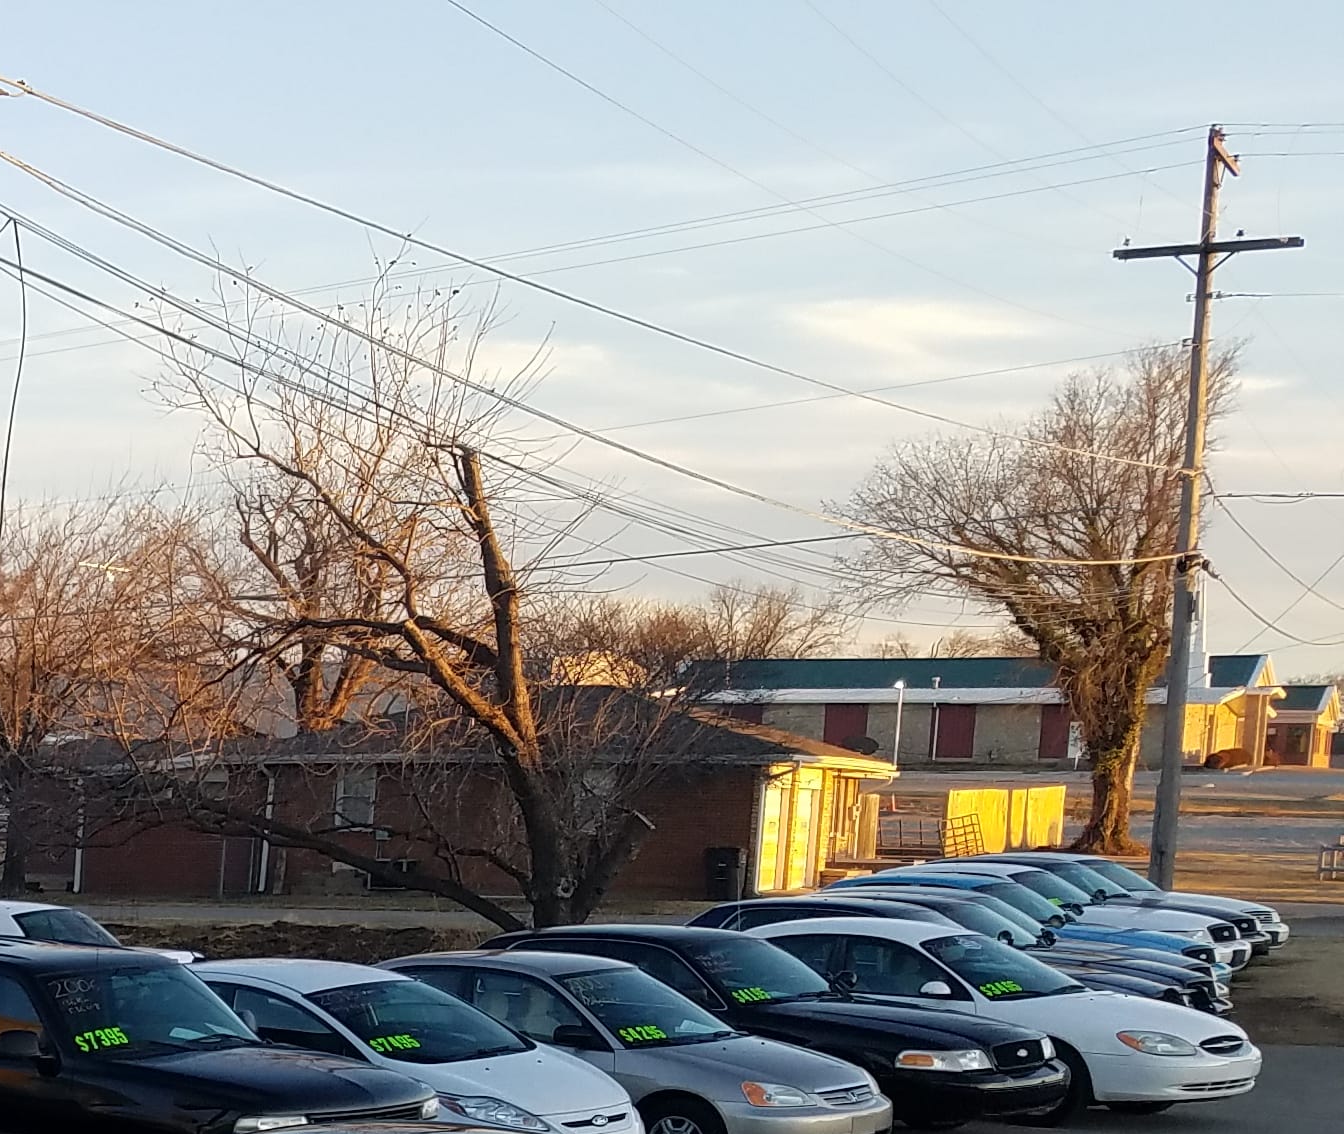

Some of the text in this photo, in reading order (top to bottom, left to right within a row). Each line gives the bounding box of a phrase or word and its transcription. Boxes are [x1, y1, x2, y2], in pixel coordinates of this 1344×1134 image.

[75, 1027, 129, 1052] $7395
[619, 1025, 667, 1042] $4295
[369, 1034, 421, 1052] $7495
